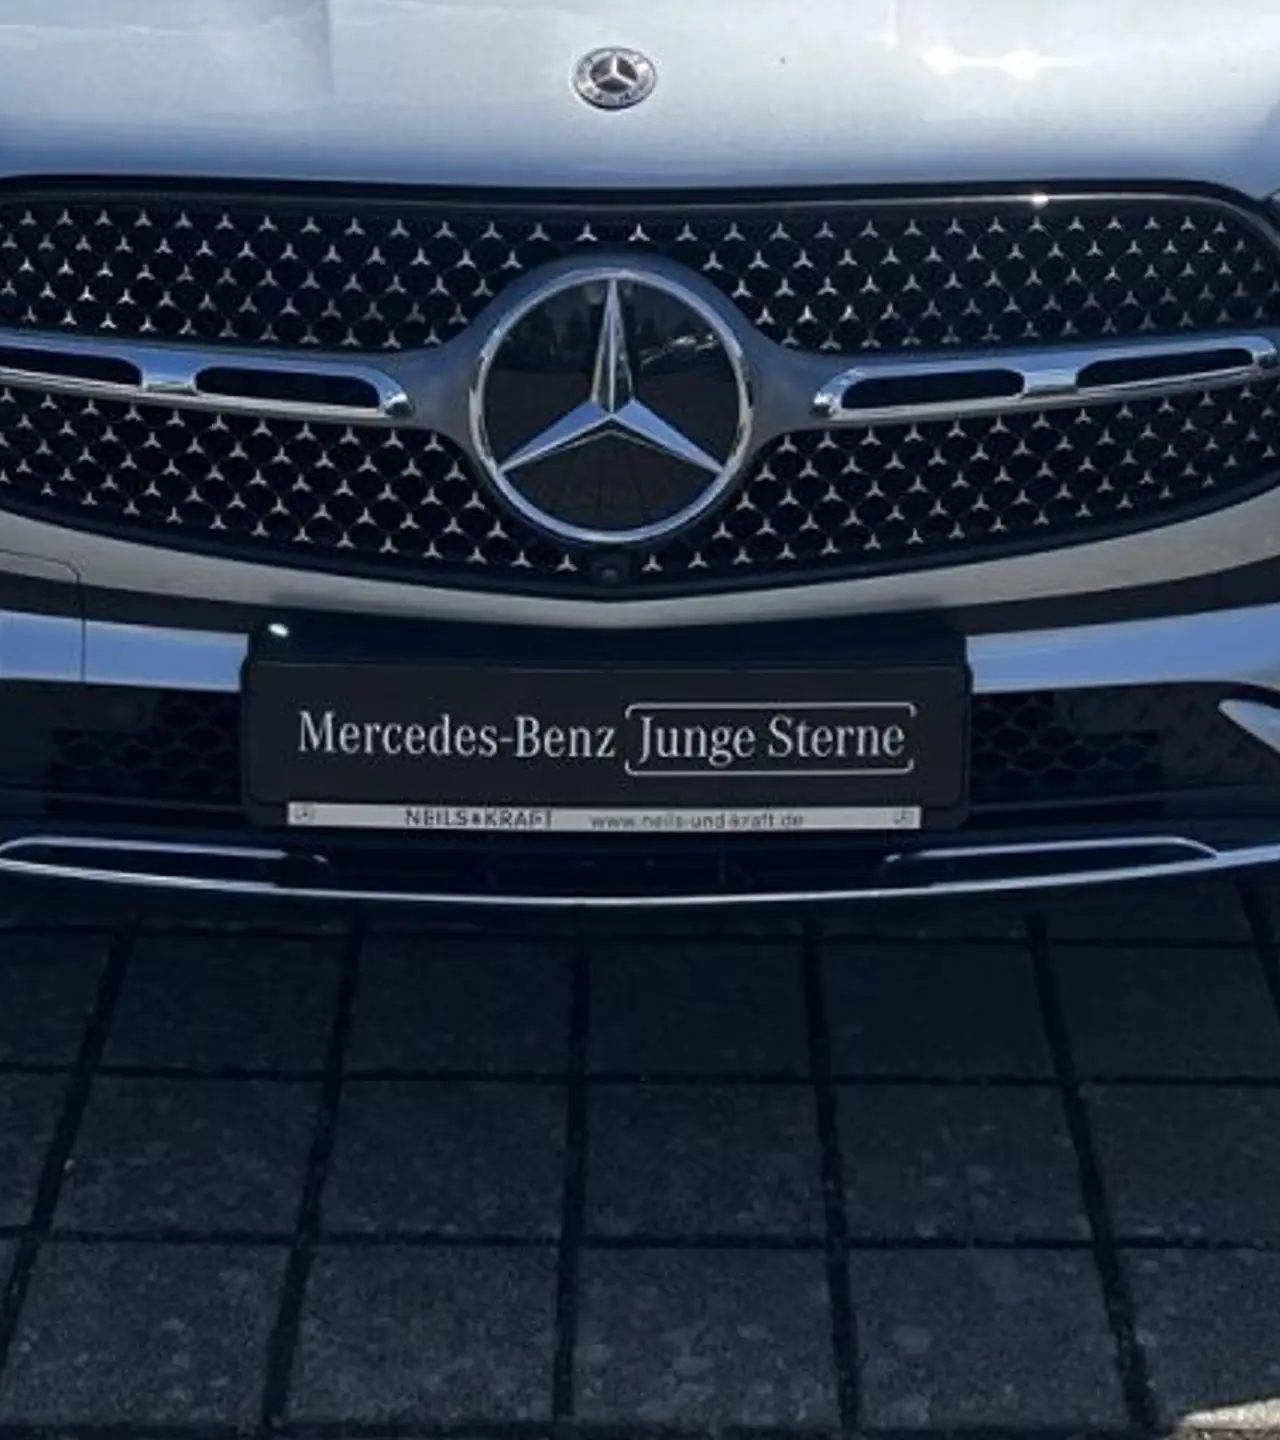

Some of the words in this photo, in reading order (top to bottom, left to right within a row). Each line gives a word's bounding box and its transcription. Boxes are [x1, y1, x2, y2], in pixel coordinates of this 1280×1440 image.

[298, 710, 616, 758] Mercedes-Benz
[638, 715, 757, 767] Junge
[767, 714, 907, 759] Sterne
